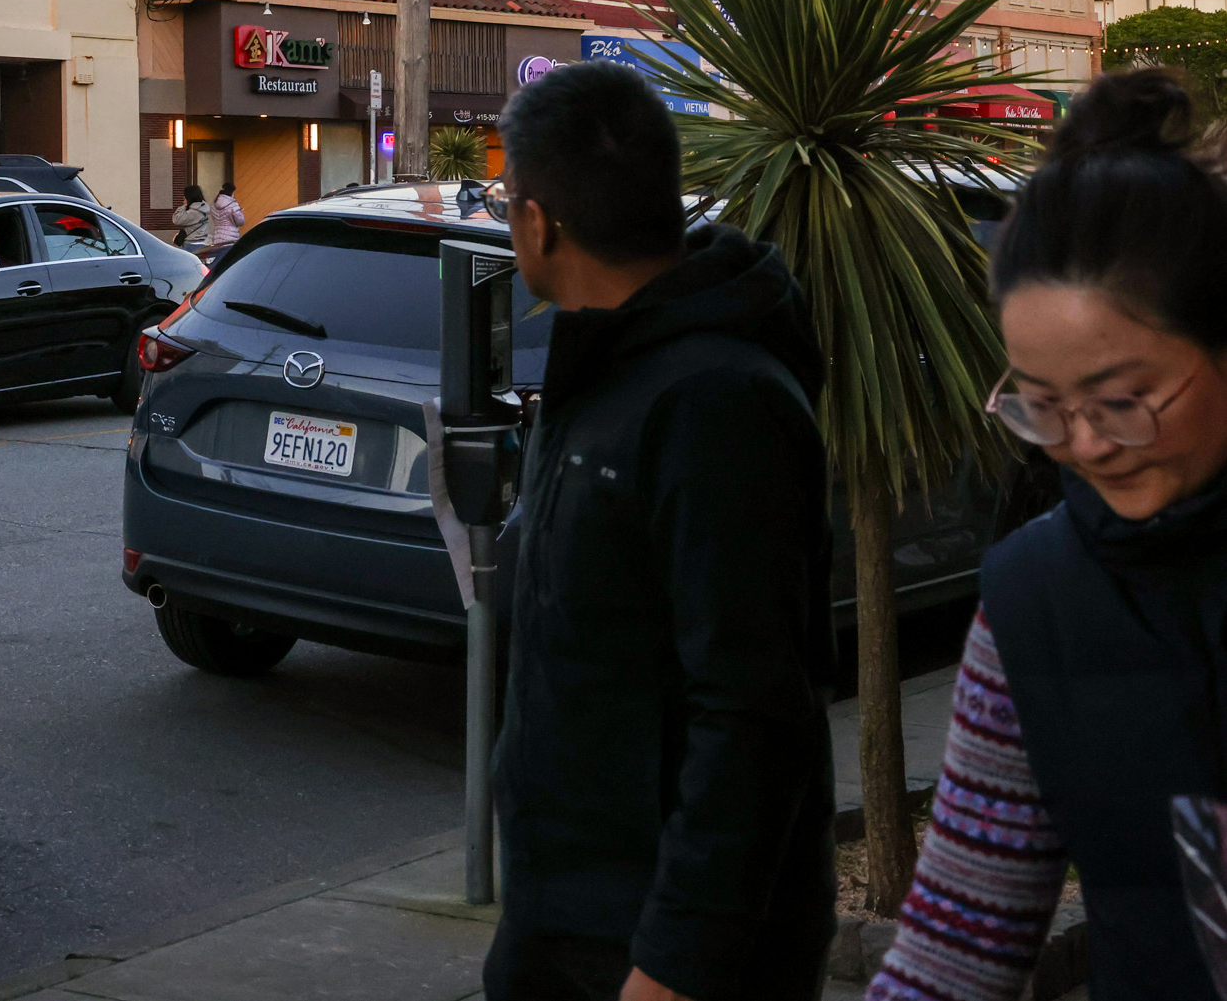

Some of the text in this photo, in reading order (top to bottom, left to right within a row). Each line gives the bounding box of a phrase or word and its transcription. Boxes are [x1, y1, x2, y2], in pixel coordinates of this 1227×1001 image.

[258, 75, 318, 93] Restaurant
[274, 417, 285, 426] DEC
[286, 417, 340, 436] California
[271, 432, 348, 467] 9EFN120
